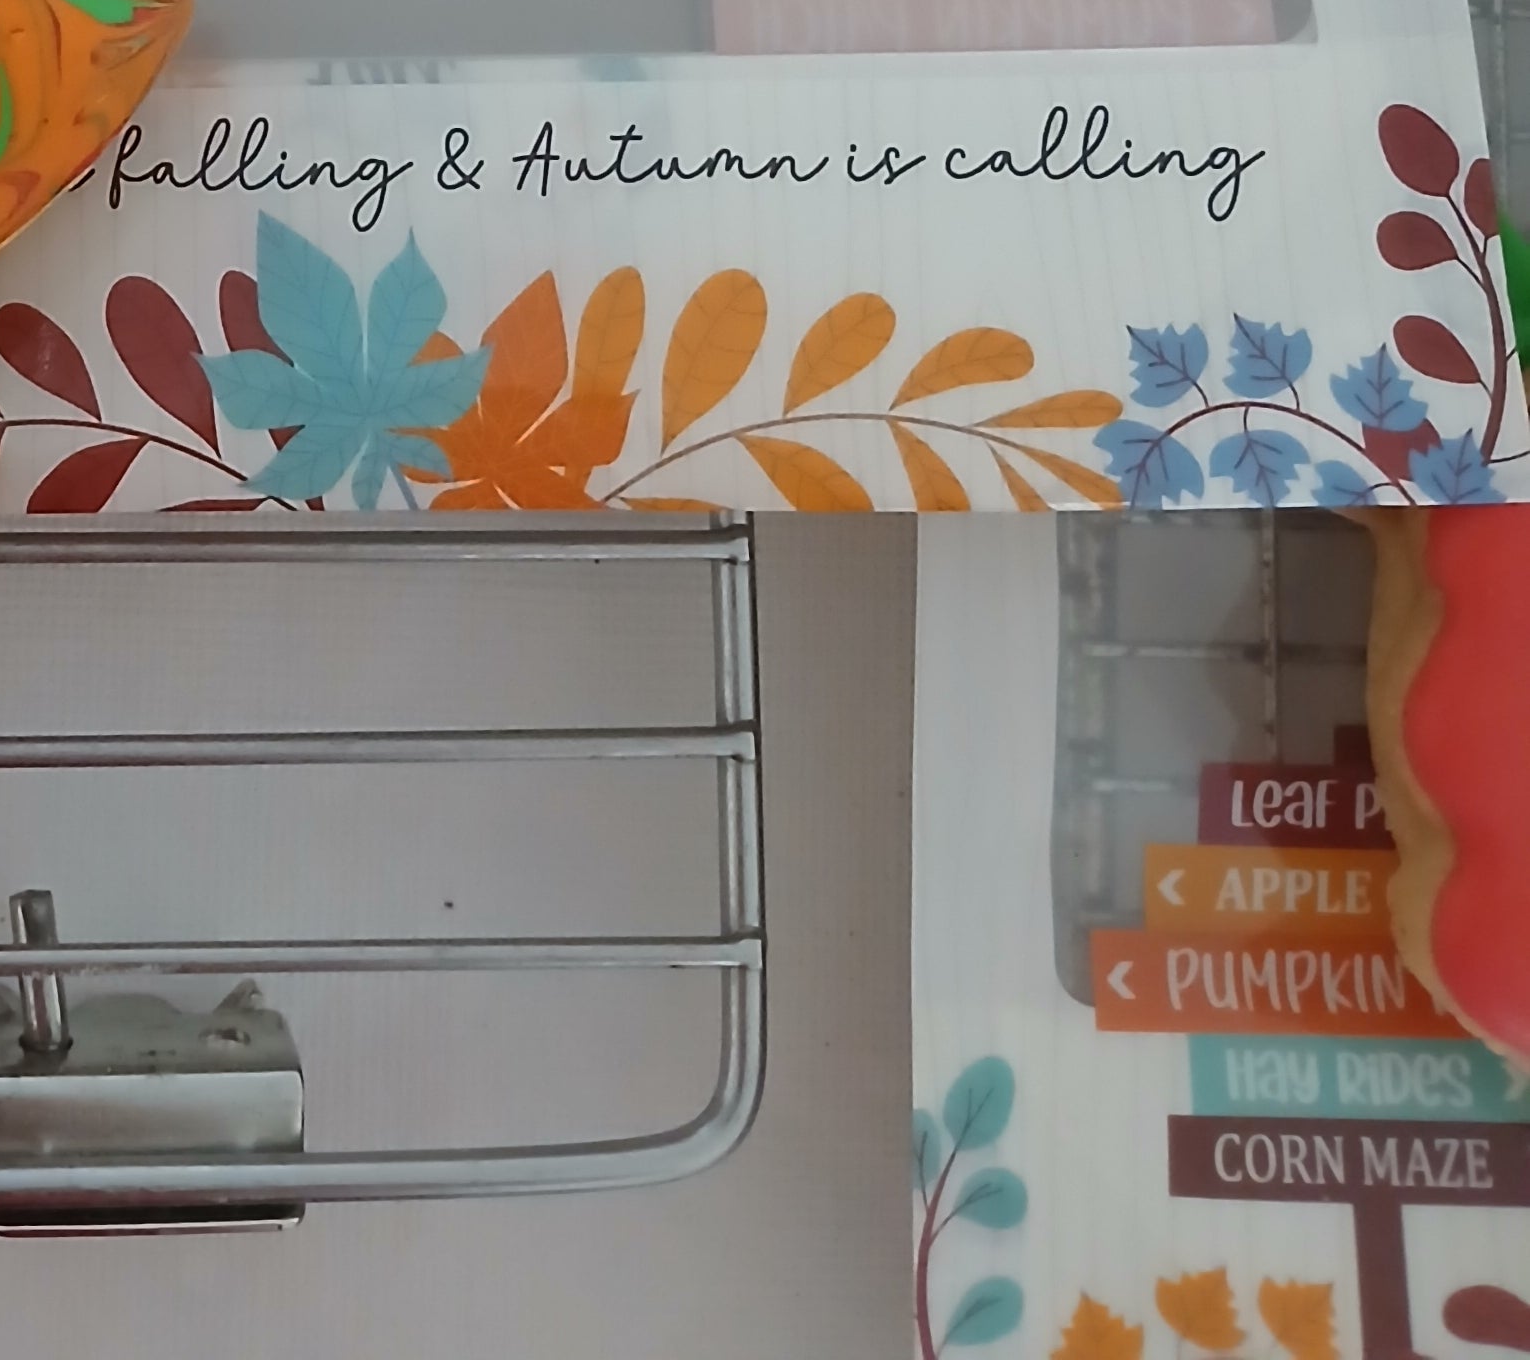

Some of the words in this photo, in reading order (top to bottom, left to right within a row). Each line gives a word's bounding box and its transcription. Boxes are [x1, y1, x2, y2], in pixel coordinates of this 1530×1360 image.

[109, 117, 414, 232] falling
[437, 127, 484, 192] &
[512, 120, 829, 197] Autumn
[846, 142, 926, 185] is
[945, 105, 1265, 222] calling
[1215, 867, 1372, 915] APPLE
[1167, 947, 1406, 1013] PUMPKIN
[1214, 1133, 1346, 1185] CORN
[1360, 1135, 1493, 1189] MAZE
